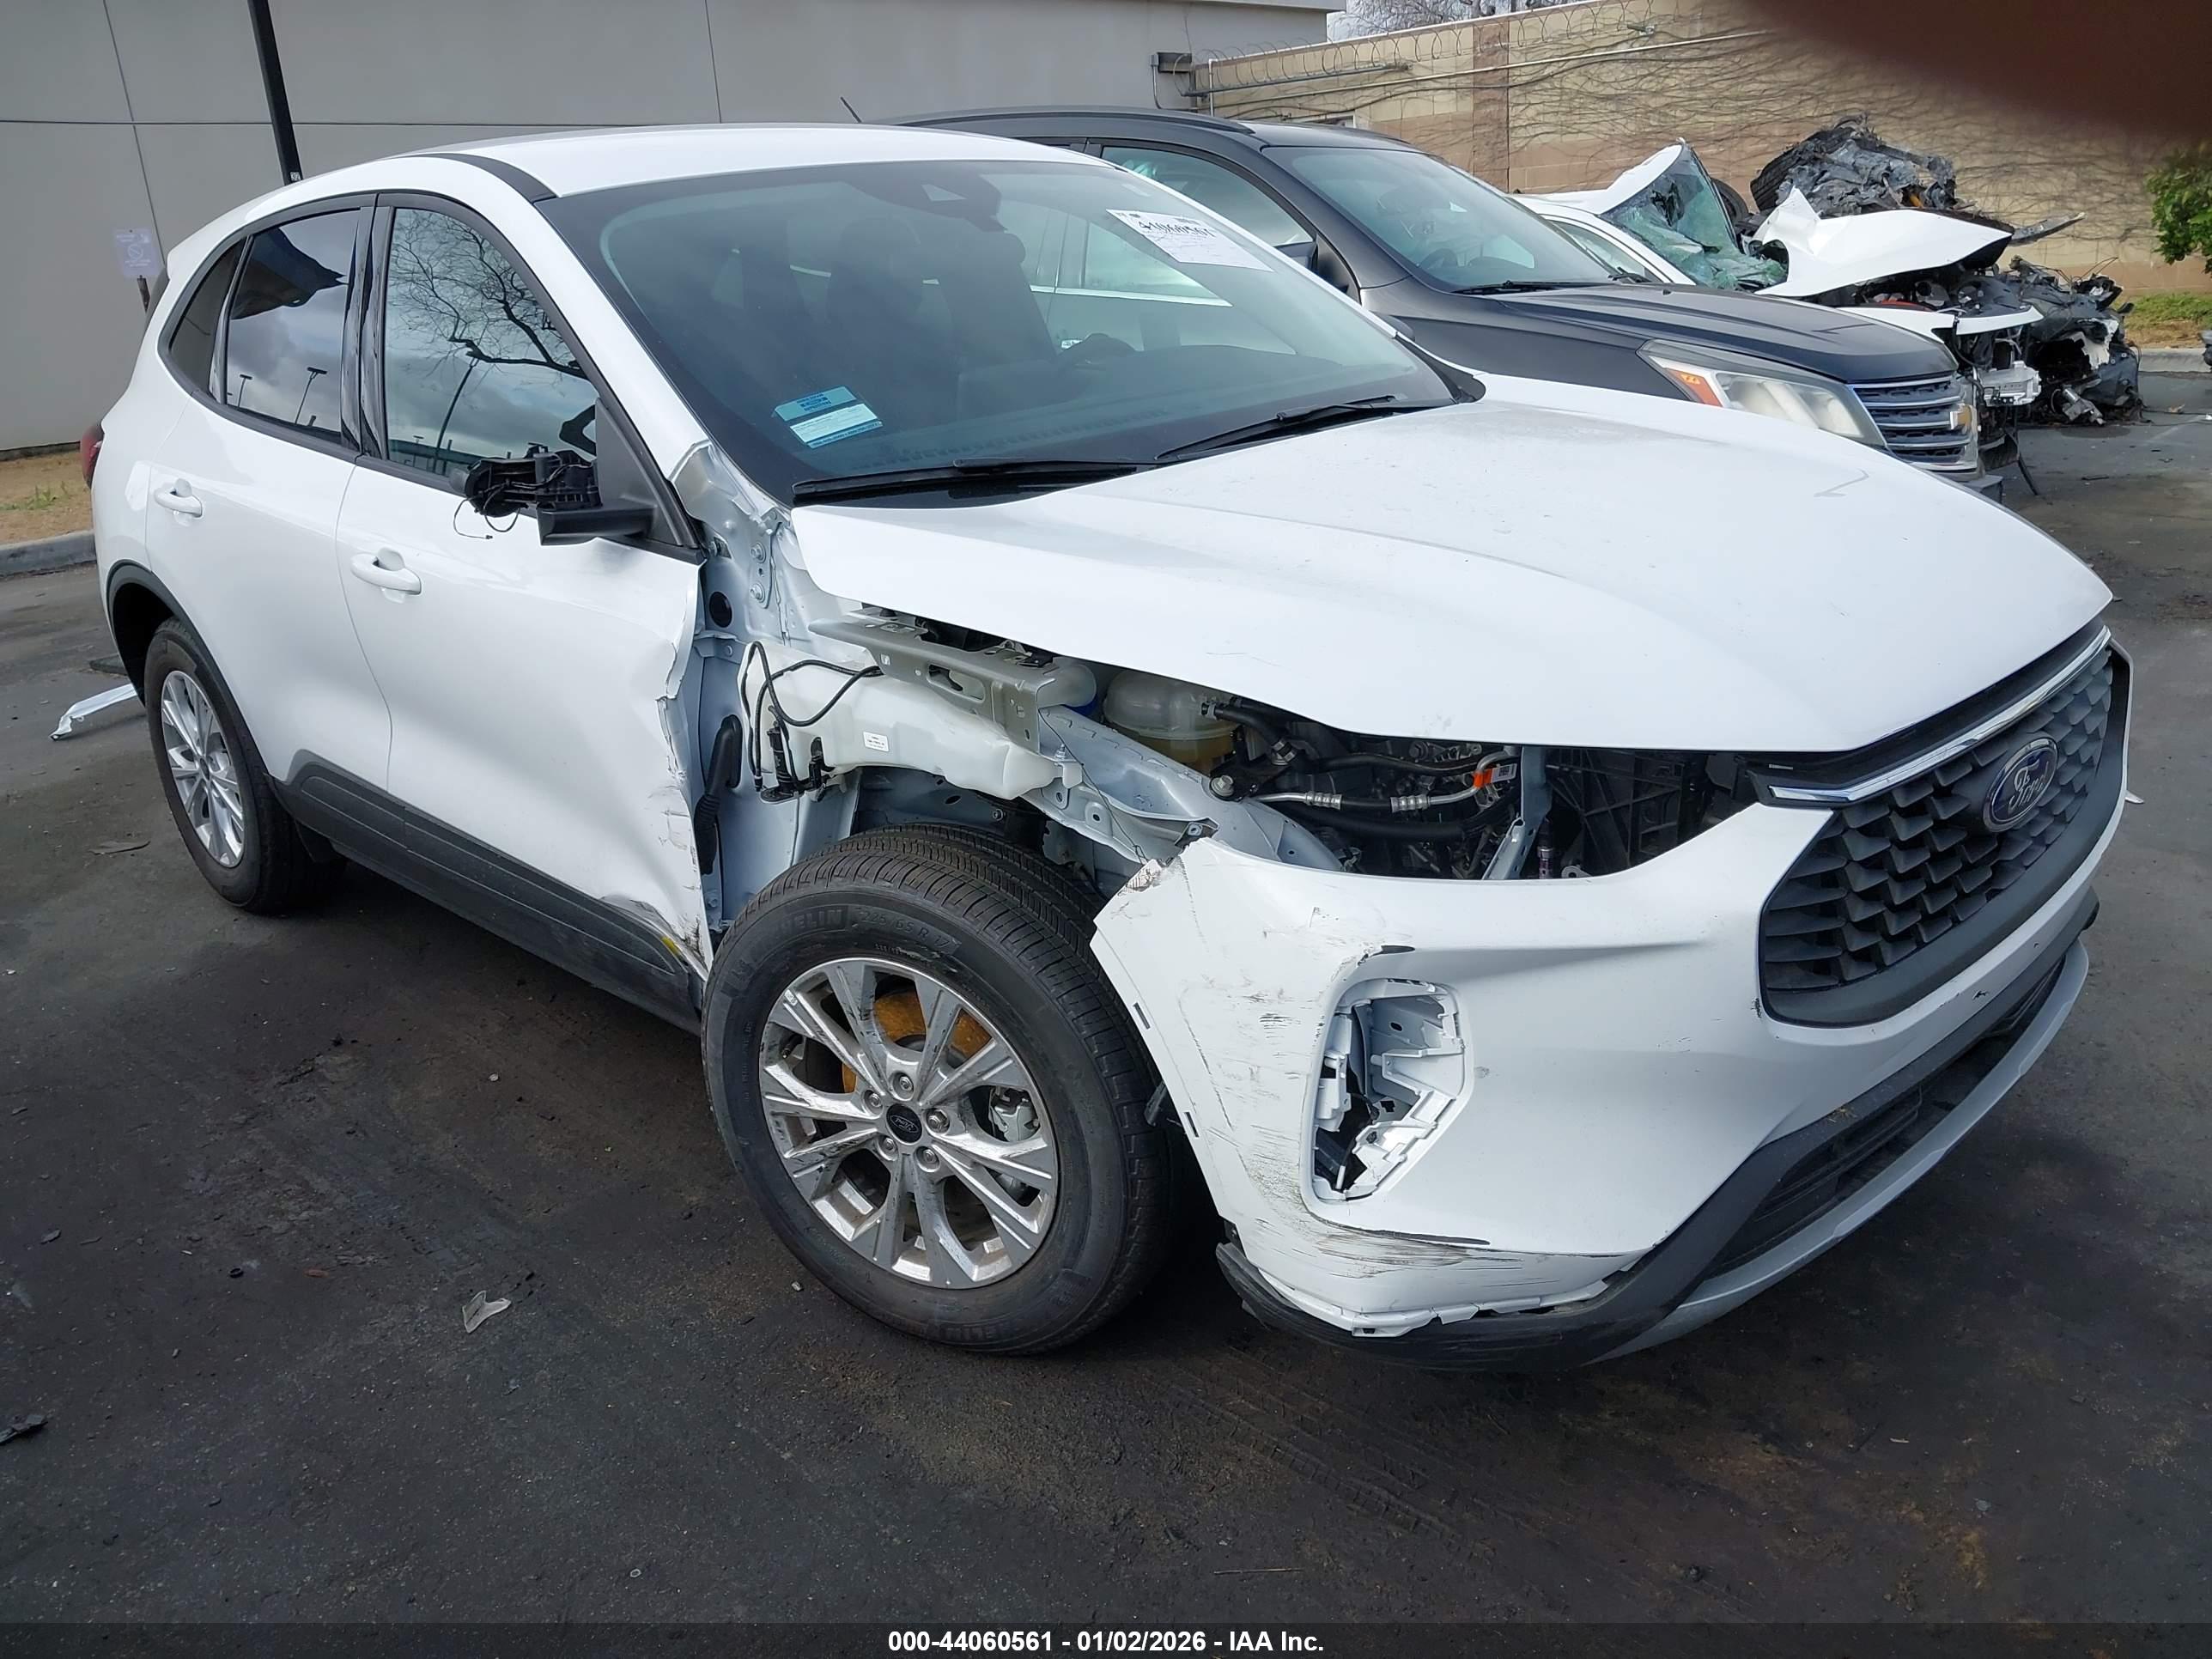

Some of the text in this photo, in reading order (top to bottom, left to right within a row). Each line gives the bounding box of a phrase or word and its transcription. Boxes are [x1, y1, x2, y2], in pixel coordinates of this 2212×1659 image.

[2008, 758, 2050, 814] Ford
[917, 926, 929, 941] R
[933, 935, 951, 948] 17
